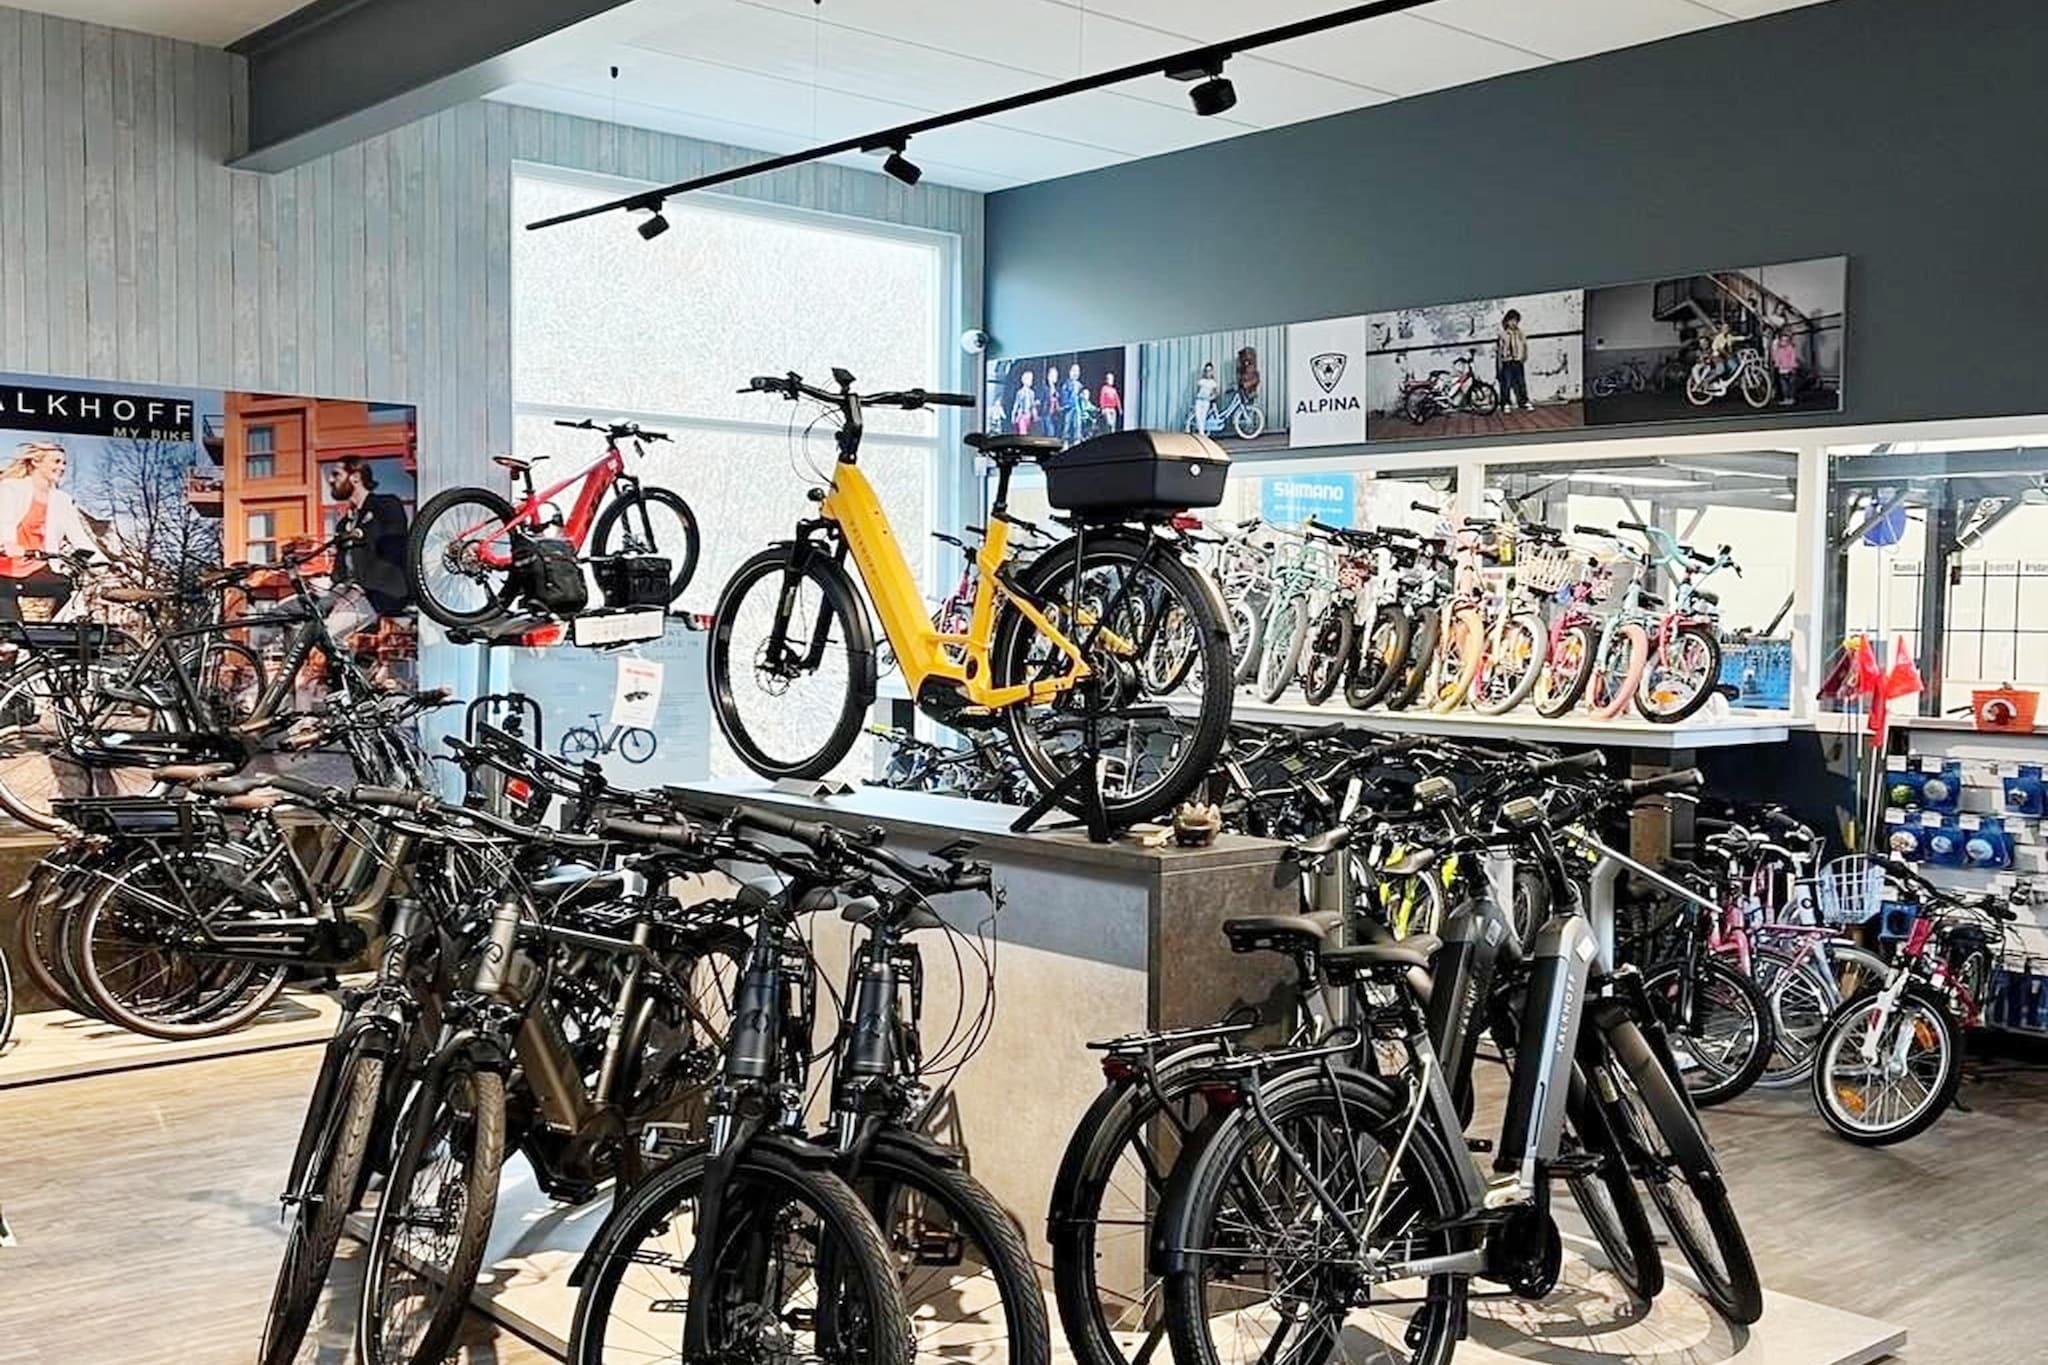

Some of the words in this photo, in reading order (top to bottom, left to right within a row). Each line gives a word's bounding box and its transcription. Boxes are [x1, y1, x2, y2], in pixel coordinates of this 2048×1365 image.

[0, 391, 192, 425] LKHOFF
[1296, 396, 1360, 414] ALPINA
[113, 427, 141, 438] MY
[150, 428, 192, 441] BIKE
[1273, 482, 1344, 501] SHIMANO
[1555, 974, 1577, 1053] KALKHOFF
